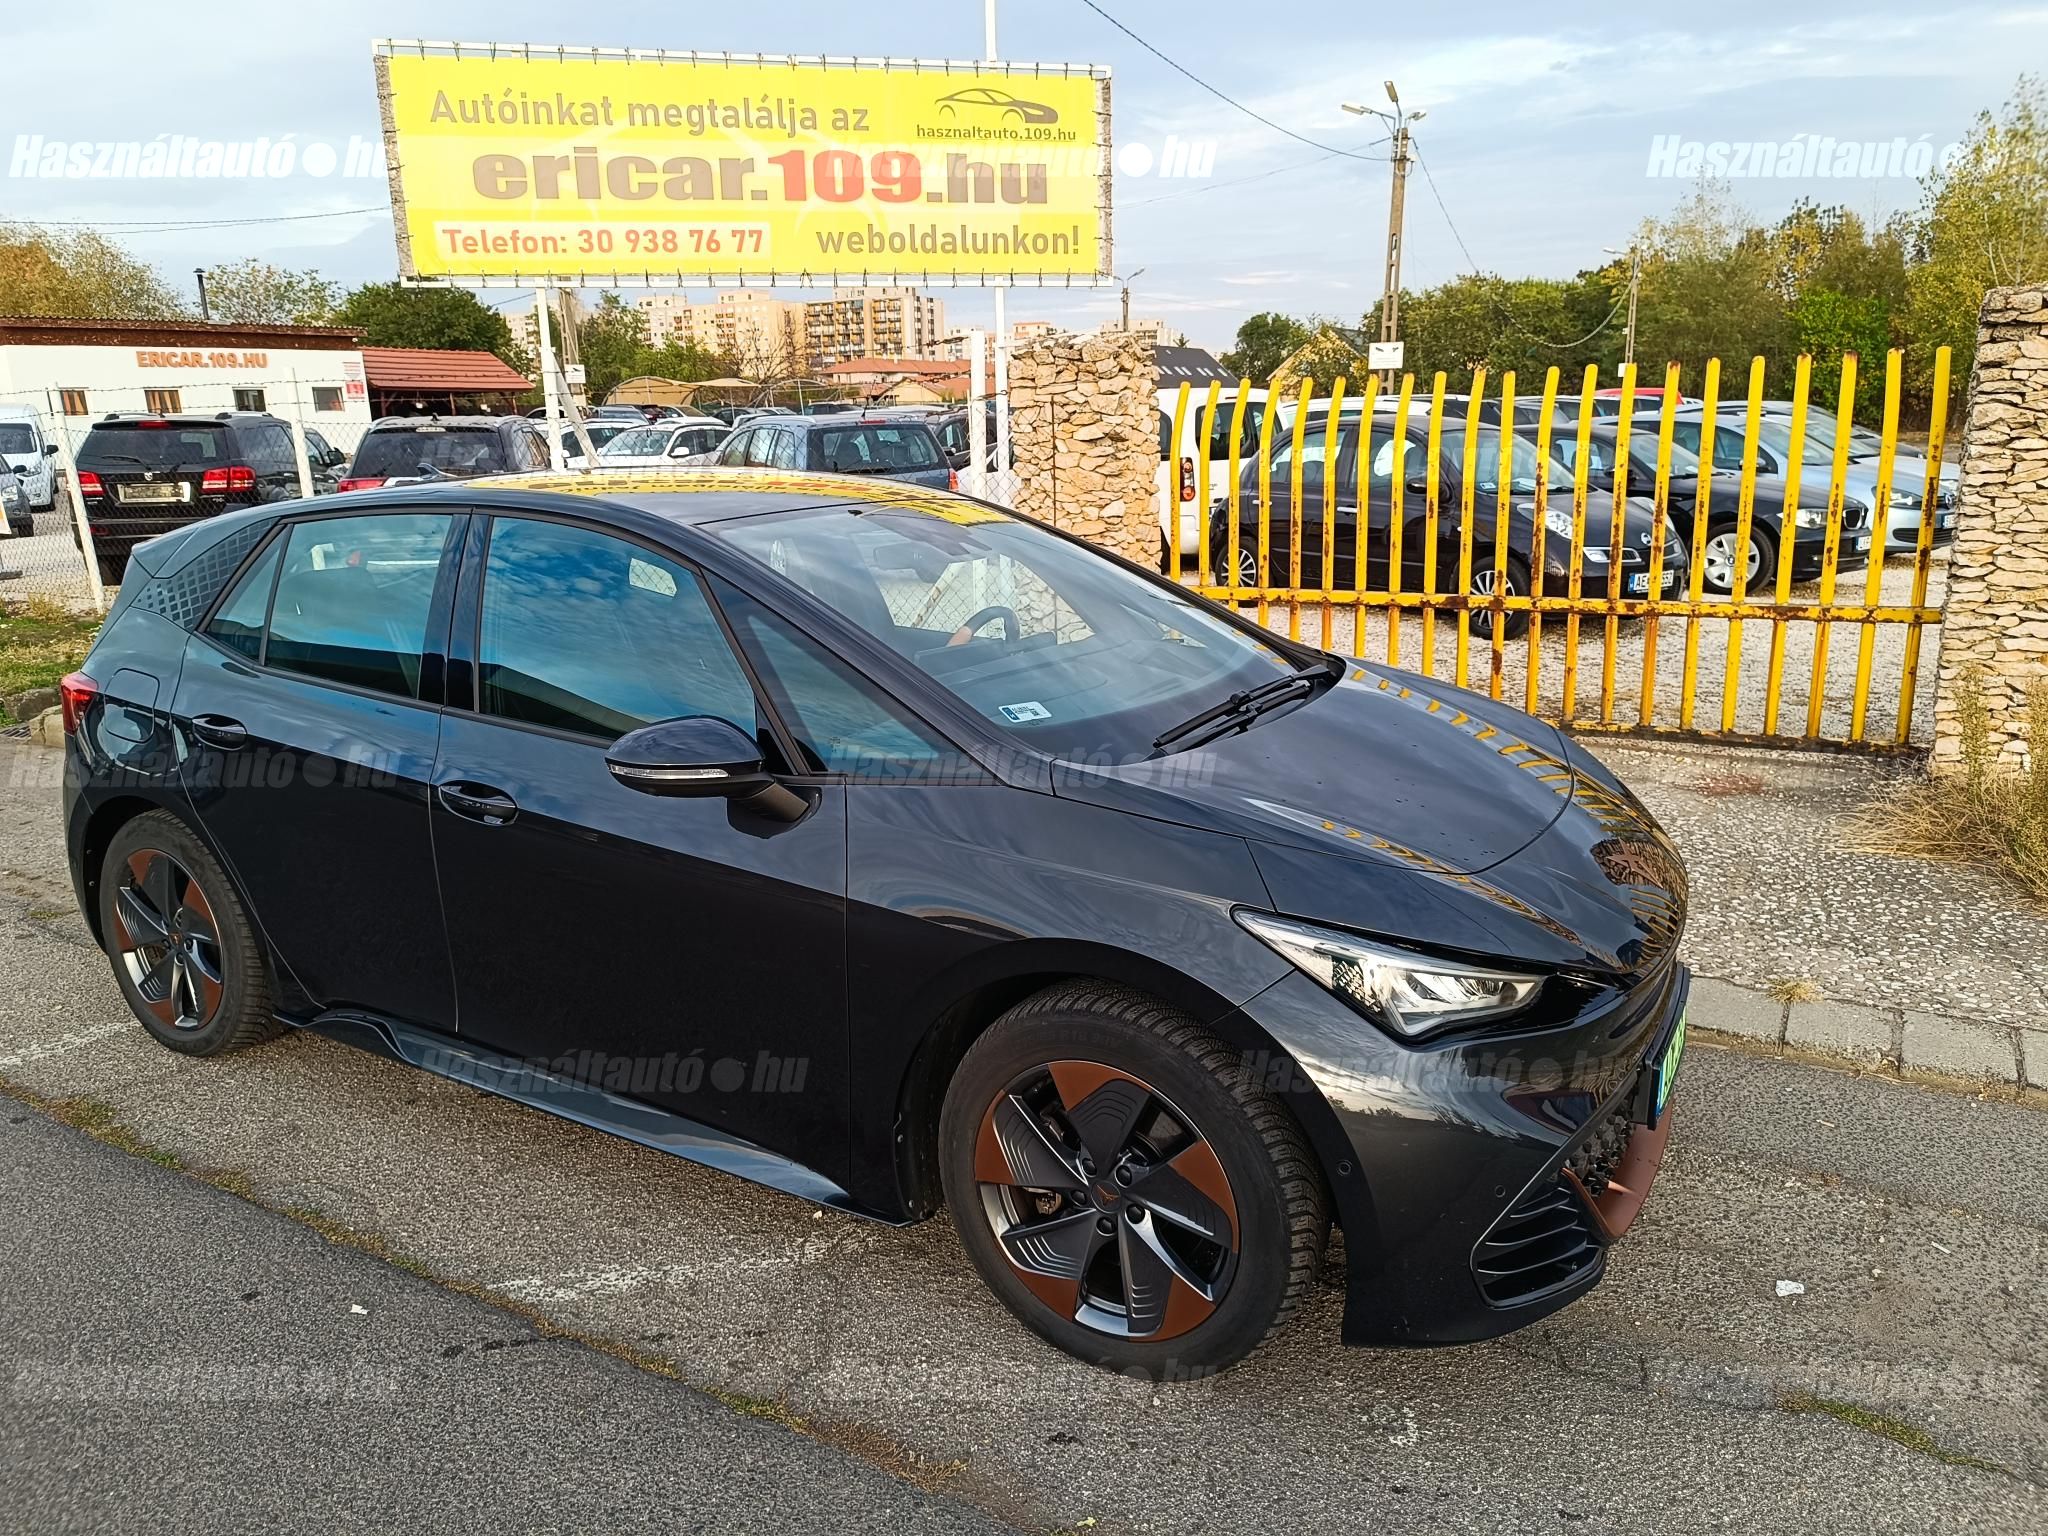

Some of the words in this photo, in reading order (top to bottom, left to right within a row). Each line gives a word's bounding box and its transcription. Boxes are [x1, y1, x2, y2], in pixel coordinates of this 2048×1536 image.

[431, 87, 614, 127] Autóinkat
[629, 94, 818, 138] megtalálja
[832, 107, 870, 131] az
[916, 124, 1077, 140] hasznaltauto.109.hu
[472, 146, 1048, 205] ericar.109.hu
[442, 229, 568, 254] Telefon:
[577, 229, 614, 253] 30
[625, 229, 679, 254] 938
[688, 229, 722, 254] 76
[731, 228, 764, 254] 77
[815, 223, 1080, 255] weboldalunkon!
[136, 351, 268, 368] ERICAR.109.HU
